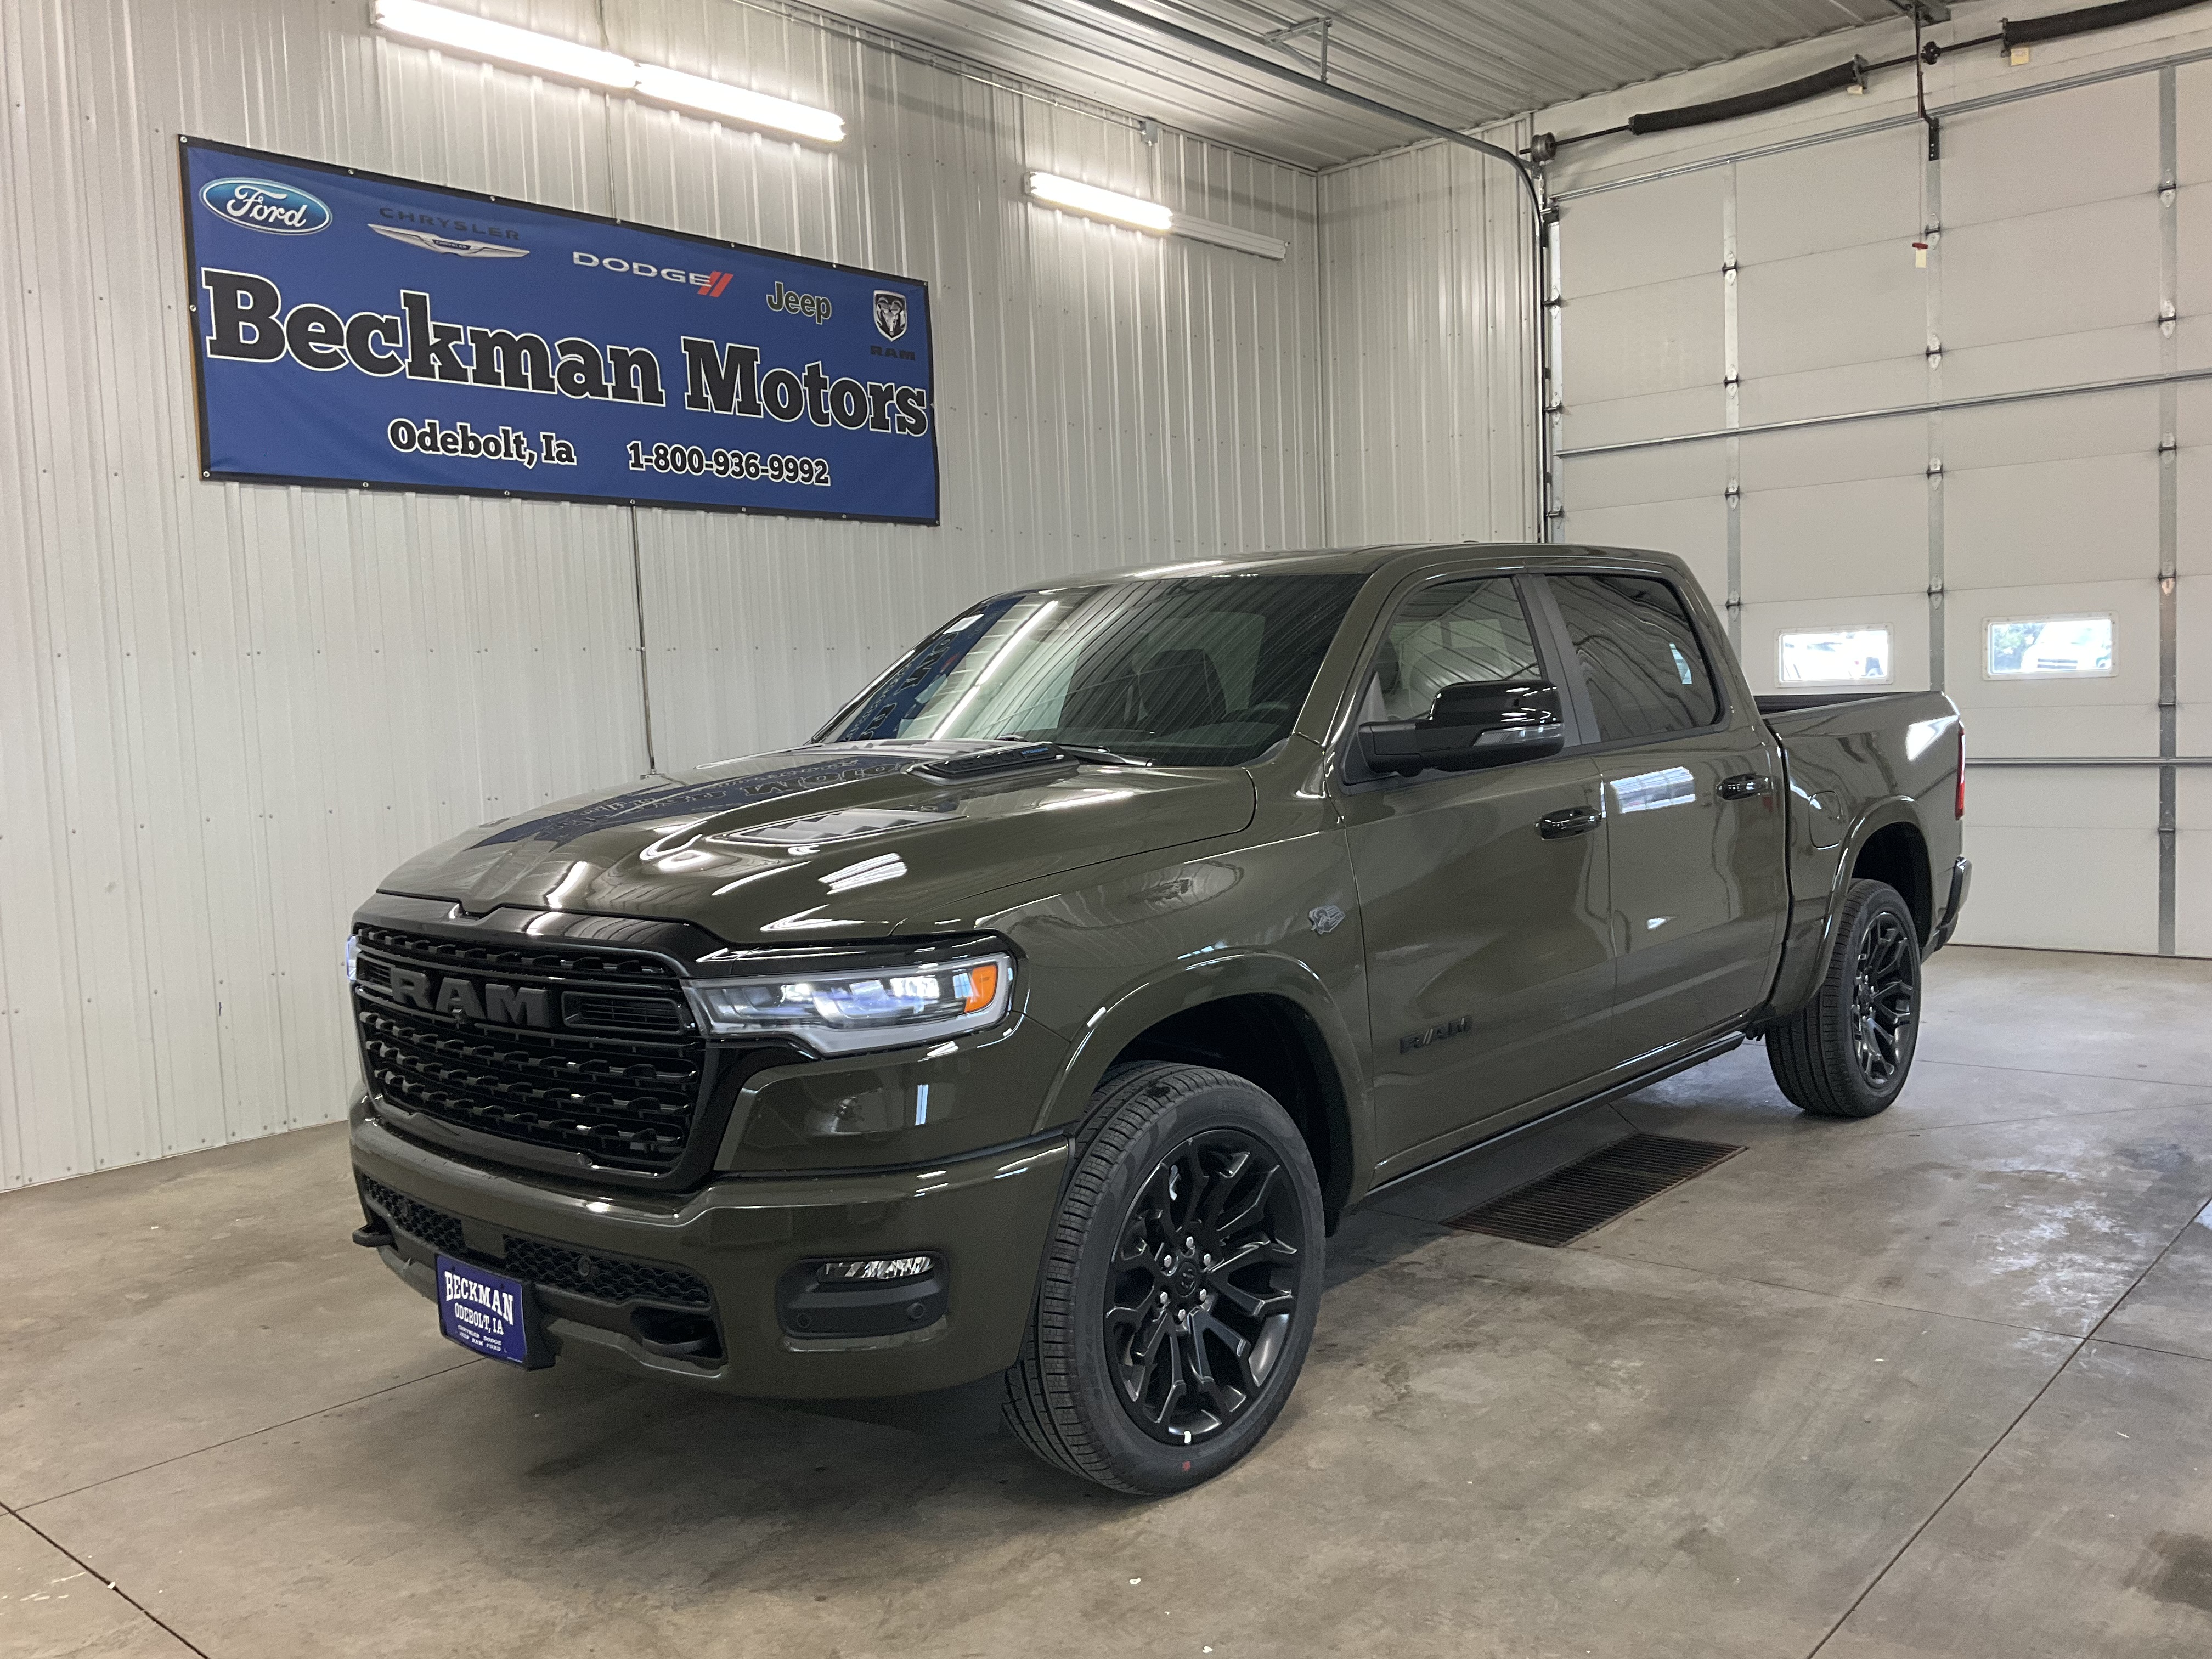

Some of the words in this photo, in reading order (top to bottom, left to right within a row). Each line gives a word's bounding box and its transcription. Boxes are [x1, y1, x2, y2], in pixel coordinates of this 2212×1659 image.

[226, 184, 308, 228] Ford
[379, 207, 520, 240] CHRYSLER
[573, 251, 712, 287] DODGE
[766, 281, 832, 325] Jeep
[201, 267, 665, 407] Beckman
[681, 336, 928, 437] Motors
[870, 345, 916, 361] RAM
[627, 441, 831, 487] 1-800-936-9992
[390, 965, 548, 1027] RAM
[1399, 1015, 1473, 1054] RAM
[444, 1271, 514, 1325] BECKMAN
[472, 1338, 483, 1346] RAM
[486, 1343, 501, 1351] FORD
